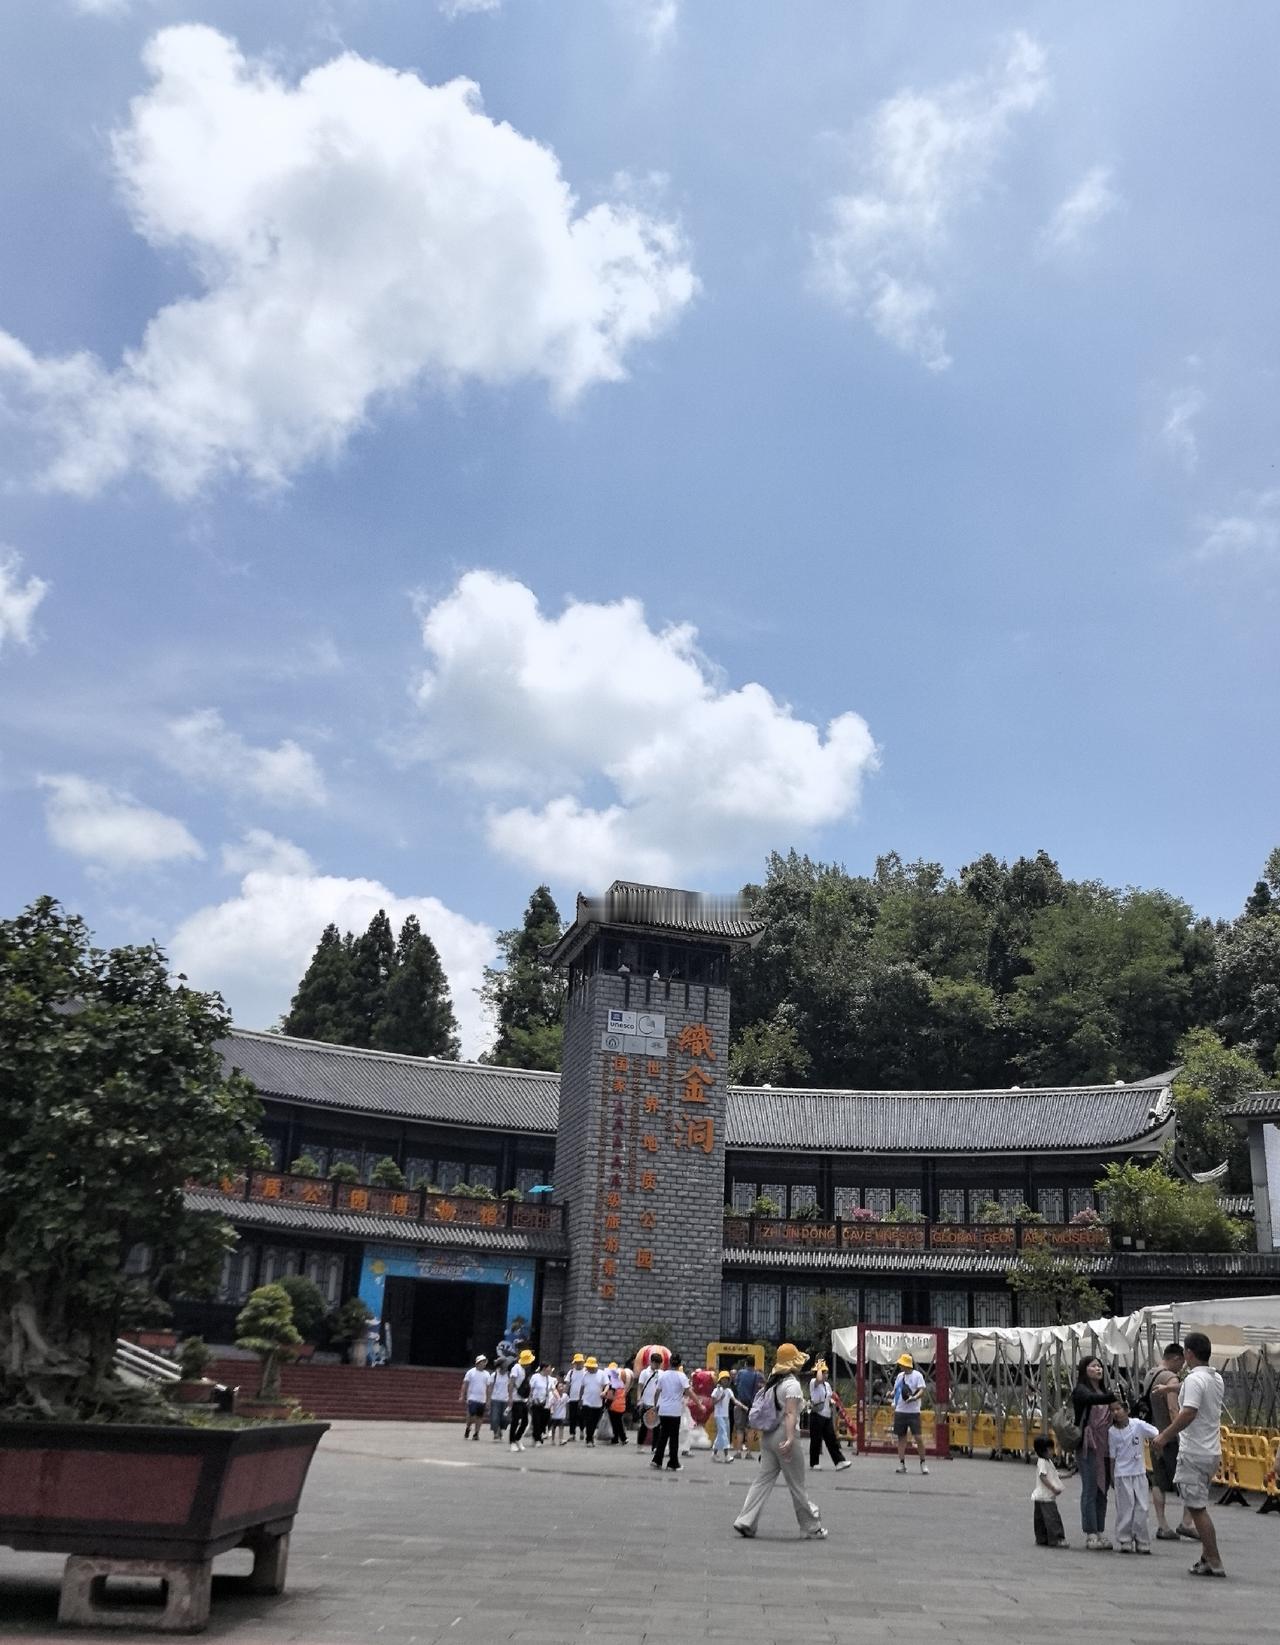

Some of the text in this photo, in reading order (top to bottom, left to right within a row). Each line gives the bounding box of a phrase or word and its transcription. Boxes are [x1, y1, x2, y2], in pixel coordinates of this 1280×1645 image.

[610, 1021, 635, 1030] unesco
[635, 1059, 660, 1269] 世界地质公园
[842, 1227, 872, 1241] CAVE
[875, 1227, 924, 1242] UNESCO
